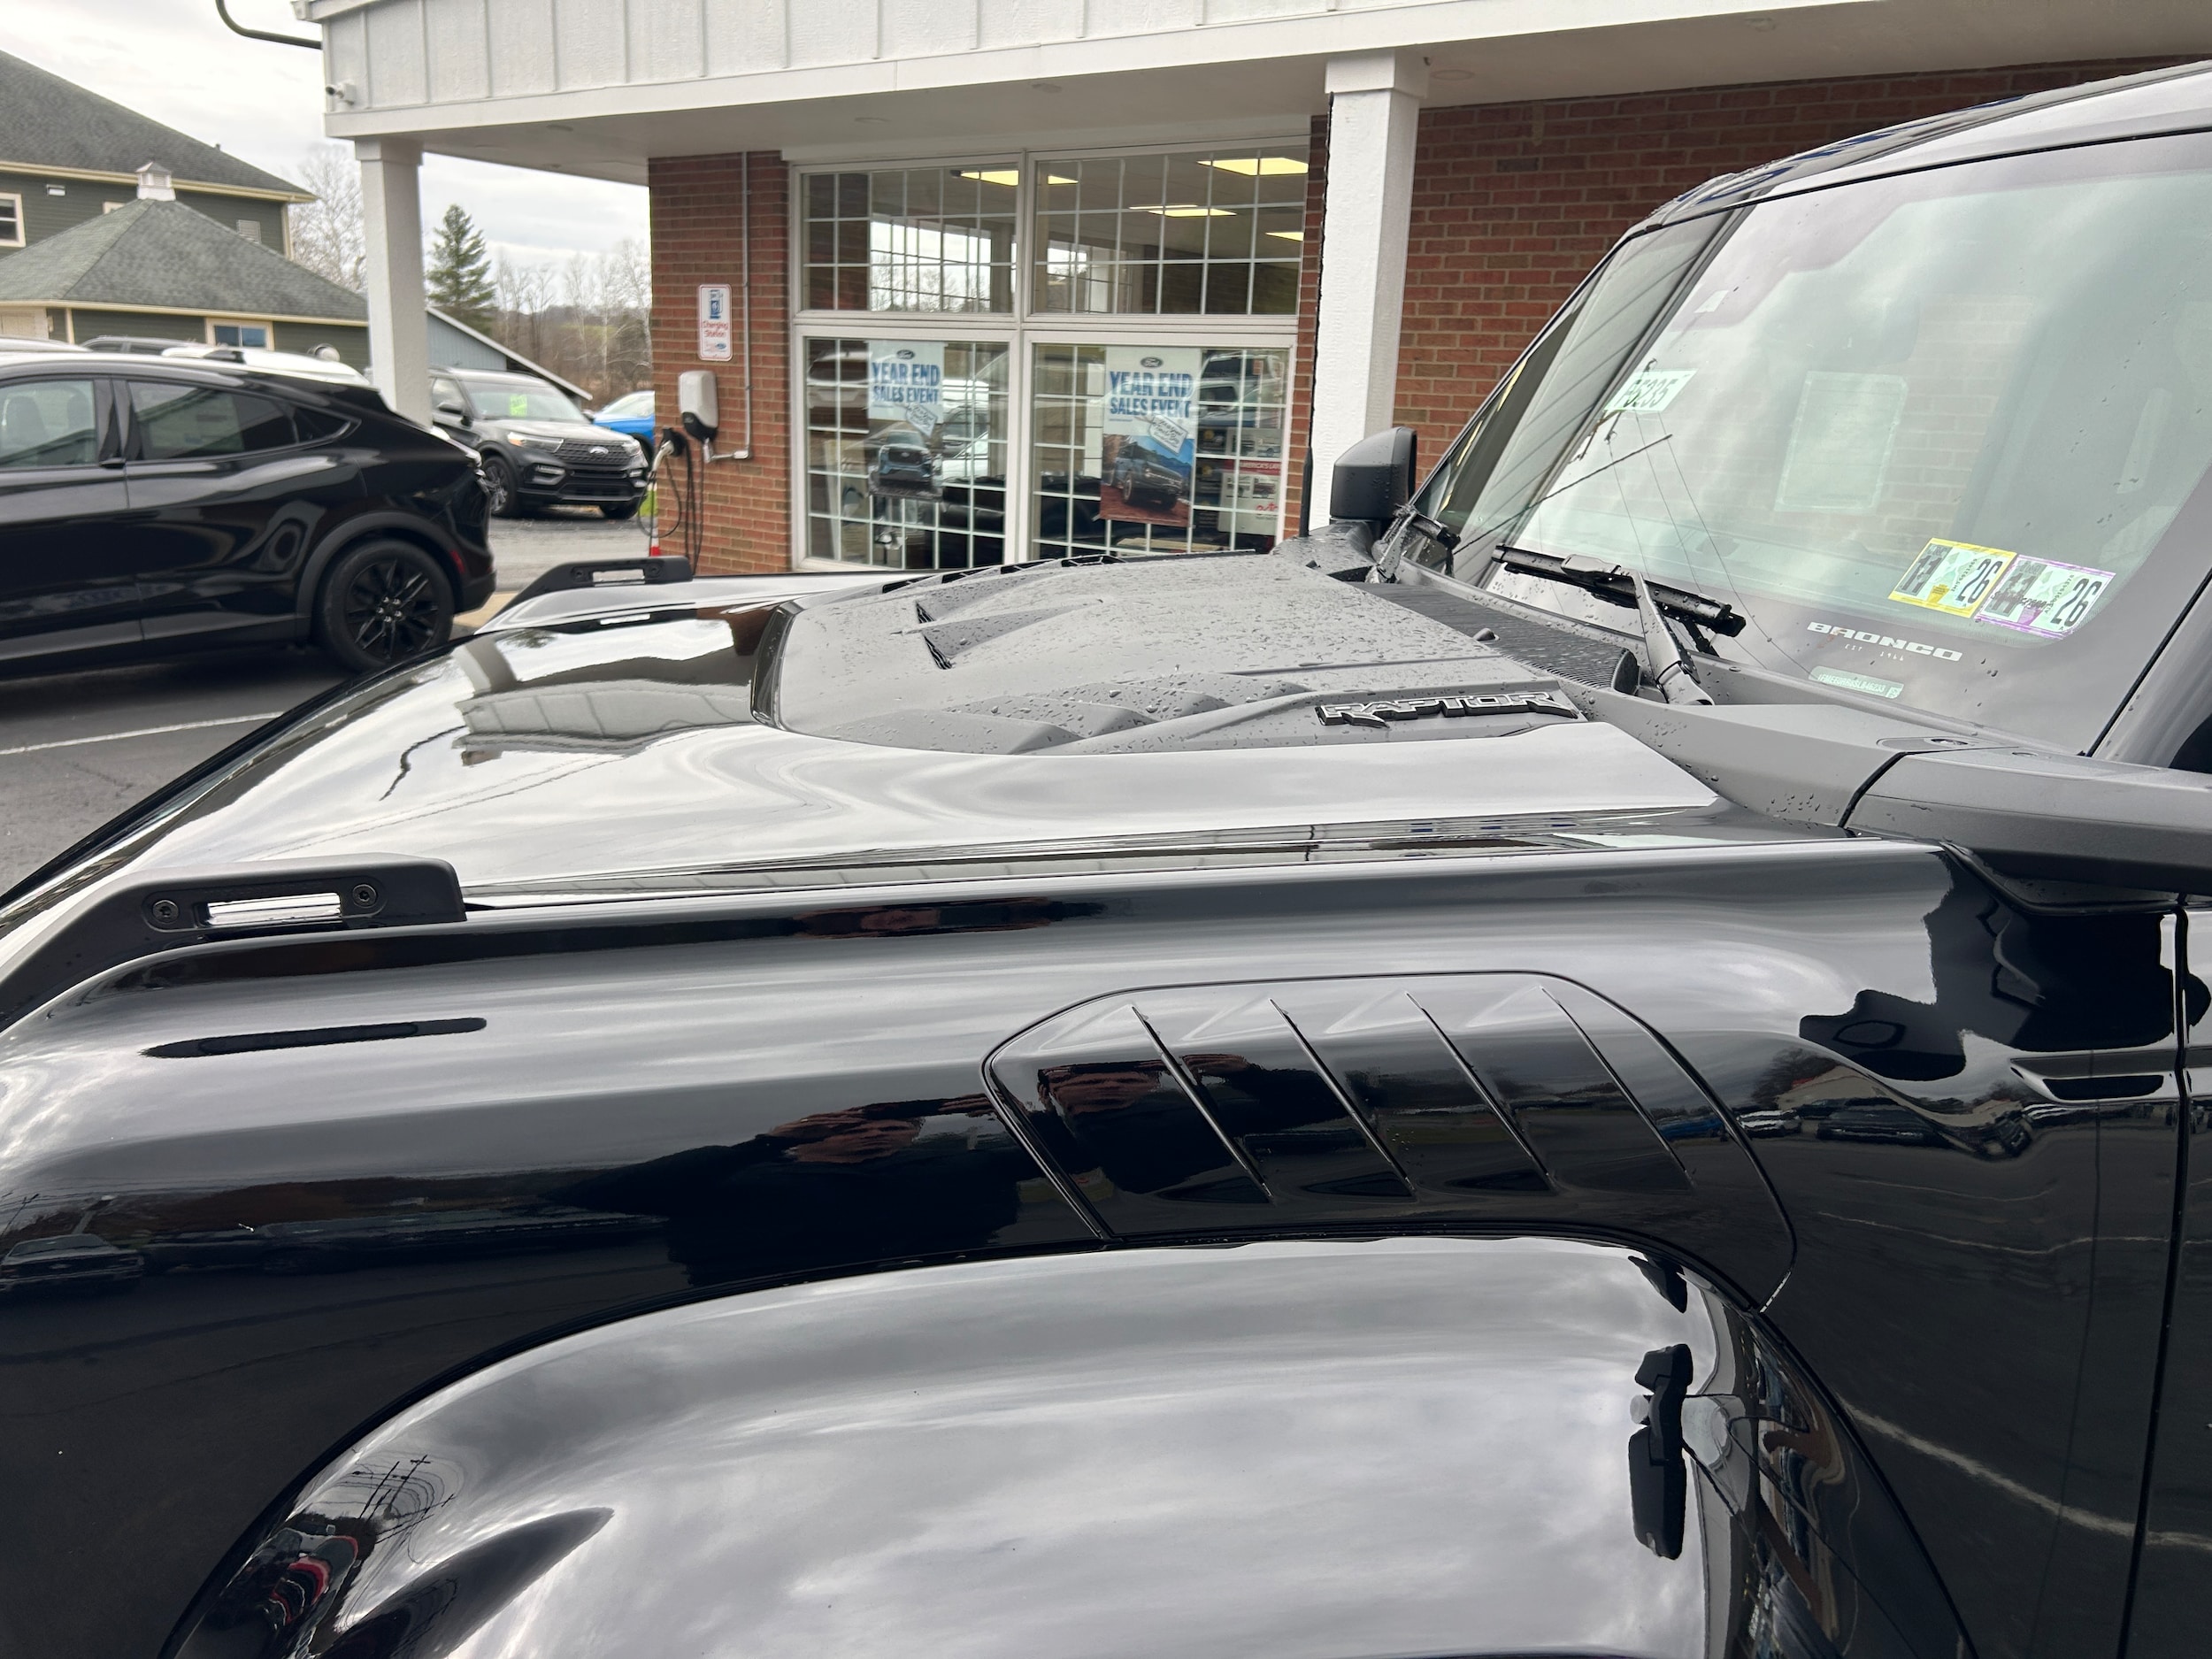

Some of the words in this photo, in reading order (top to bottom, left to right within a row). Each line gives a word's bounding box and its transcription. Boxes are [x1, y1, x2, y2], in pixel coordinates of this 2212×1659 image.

[872, 362, 909, 385] YEAR
[912, 364, 941, 386] END
[1110, 371, 1154, 396] YEAR
[1159, 373, 1193, 397] END
[873, 386, 904, 402] SALES
[906, 388, 939, 403] EVENT
[1110, 398, 1148, 416] SALES
[1151, 399, 1192, 419] EVENT
[1955, 558, 2003, 603] 26
[2050, 578, 2102, 627] 26
[1807, 621, 1963, 662] BRONCO
[1315, 691, 1578, 728] RAPTOR
